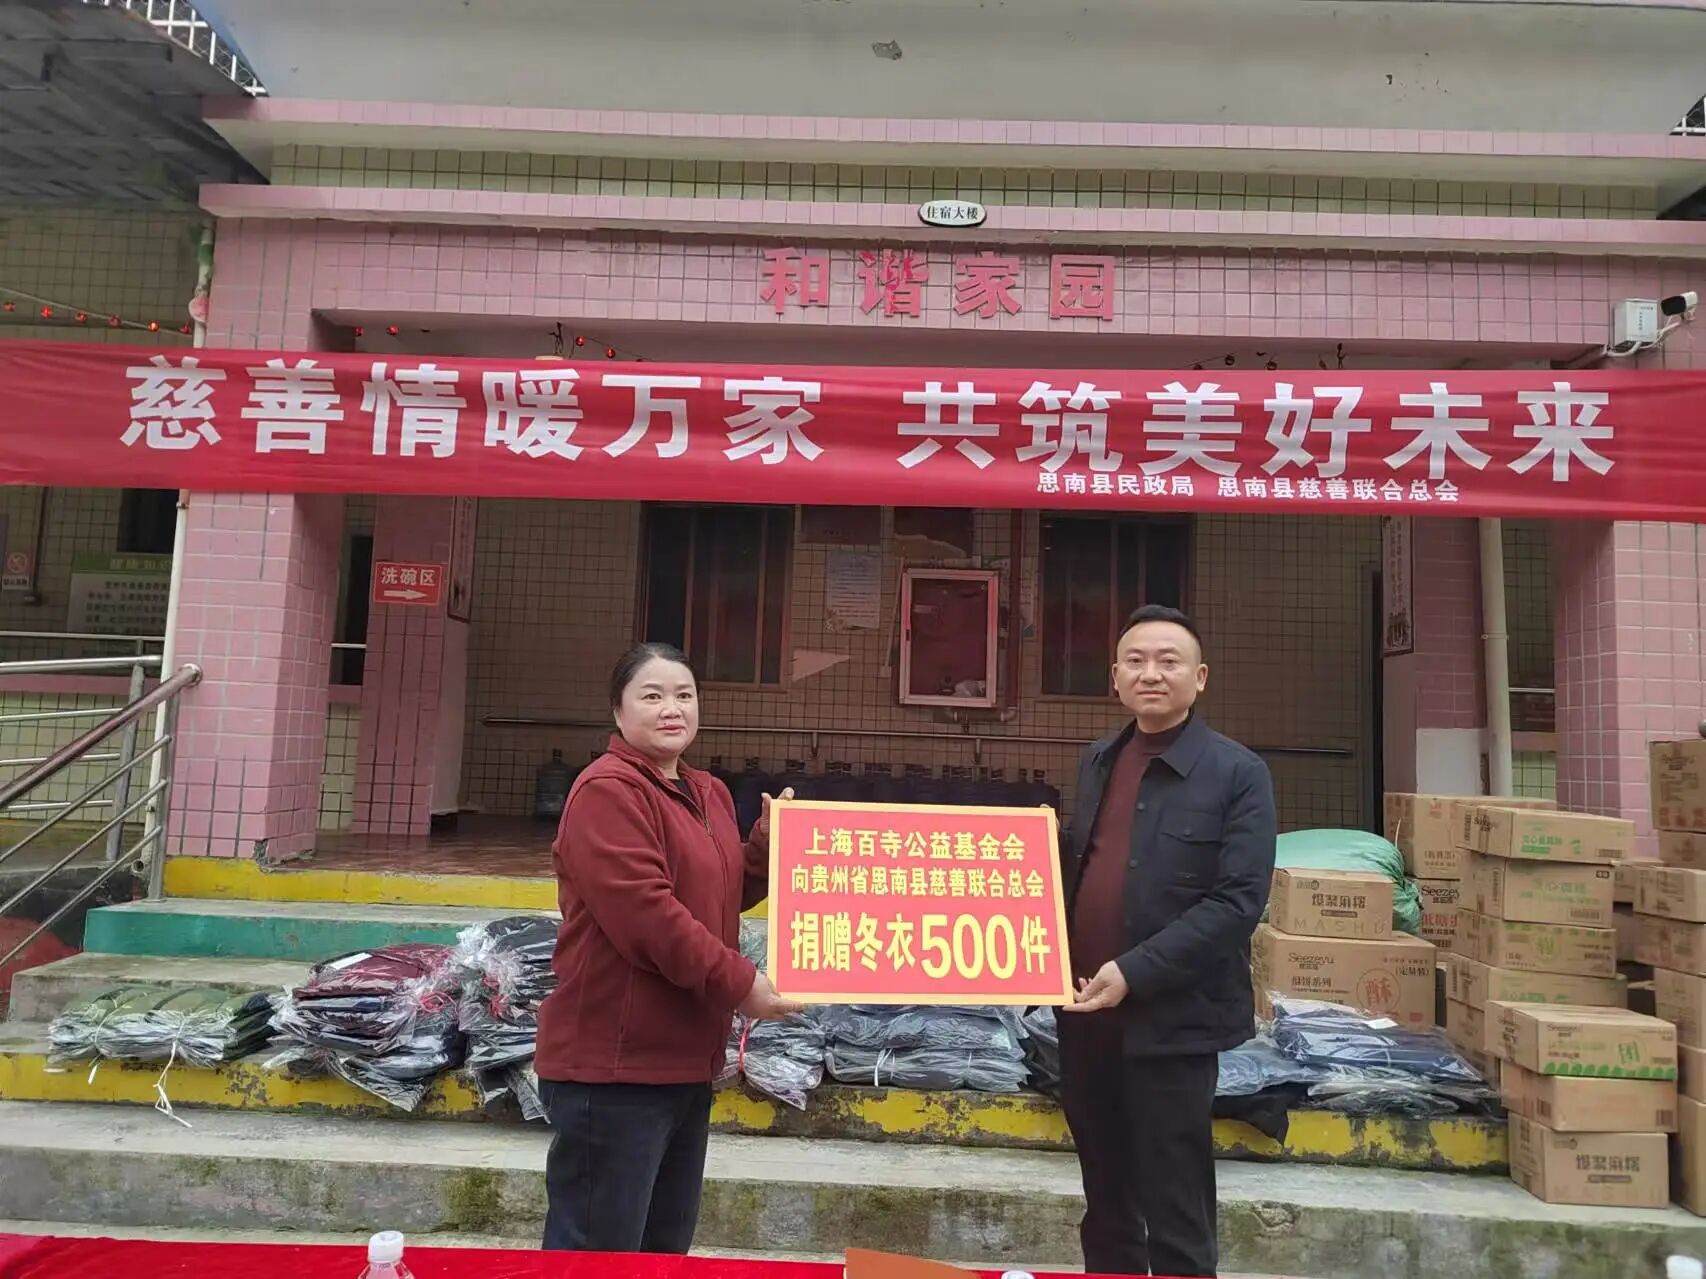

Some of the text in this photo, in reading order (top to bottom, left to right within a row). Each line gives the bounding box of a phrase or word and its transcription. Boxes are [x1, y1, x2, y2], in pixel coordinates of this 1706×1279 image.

[927, 206, 978, 221] 住宿大楼
[759, 246, 1115, 322] 和谐家园
[121, 355, 1616, 482] 慈善情暖万家 共筑美好未来
[1037, 472, 1459, 502] 思南县民政局 思南县慈善联合总会
[381, 567, 436, 586] 洗碗区
[804, 827, 1026, 861] 上海百寺公益基金会
[791, 865, 1045, 898] 向贵州省思南县慈善联合总会
[790, 910, 1051, 980] 捐赠冬衣500件
